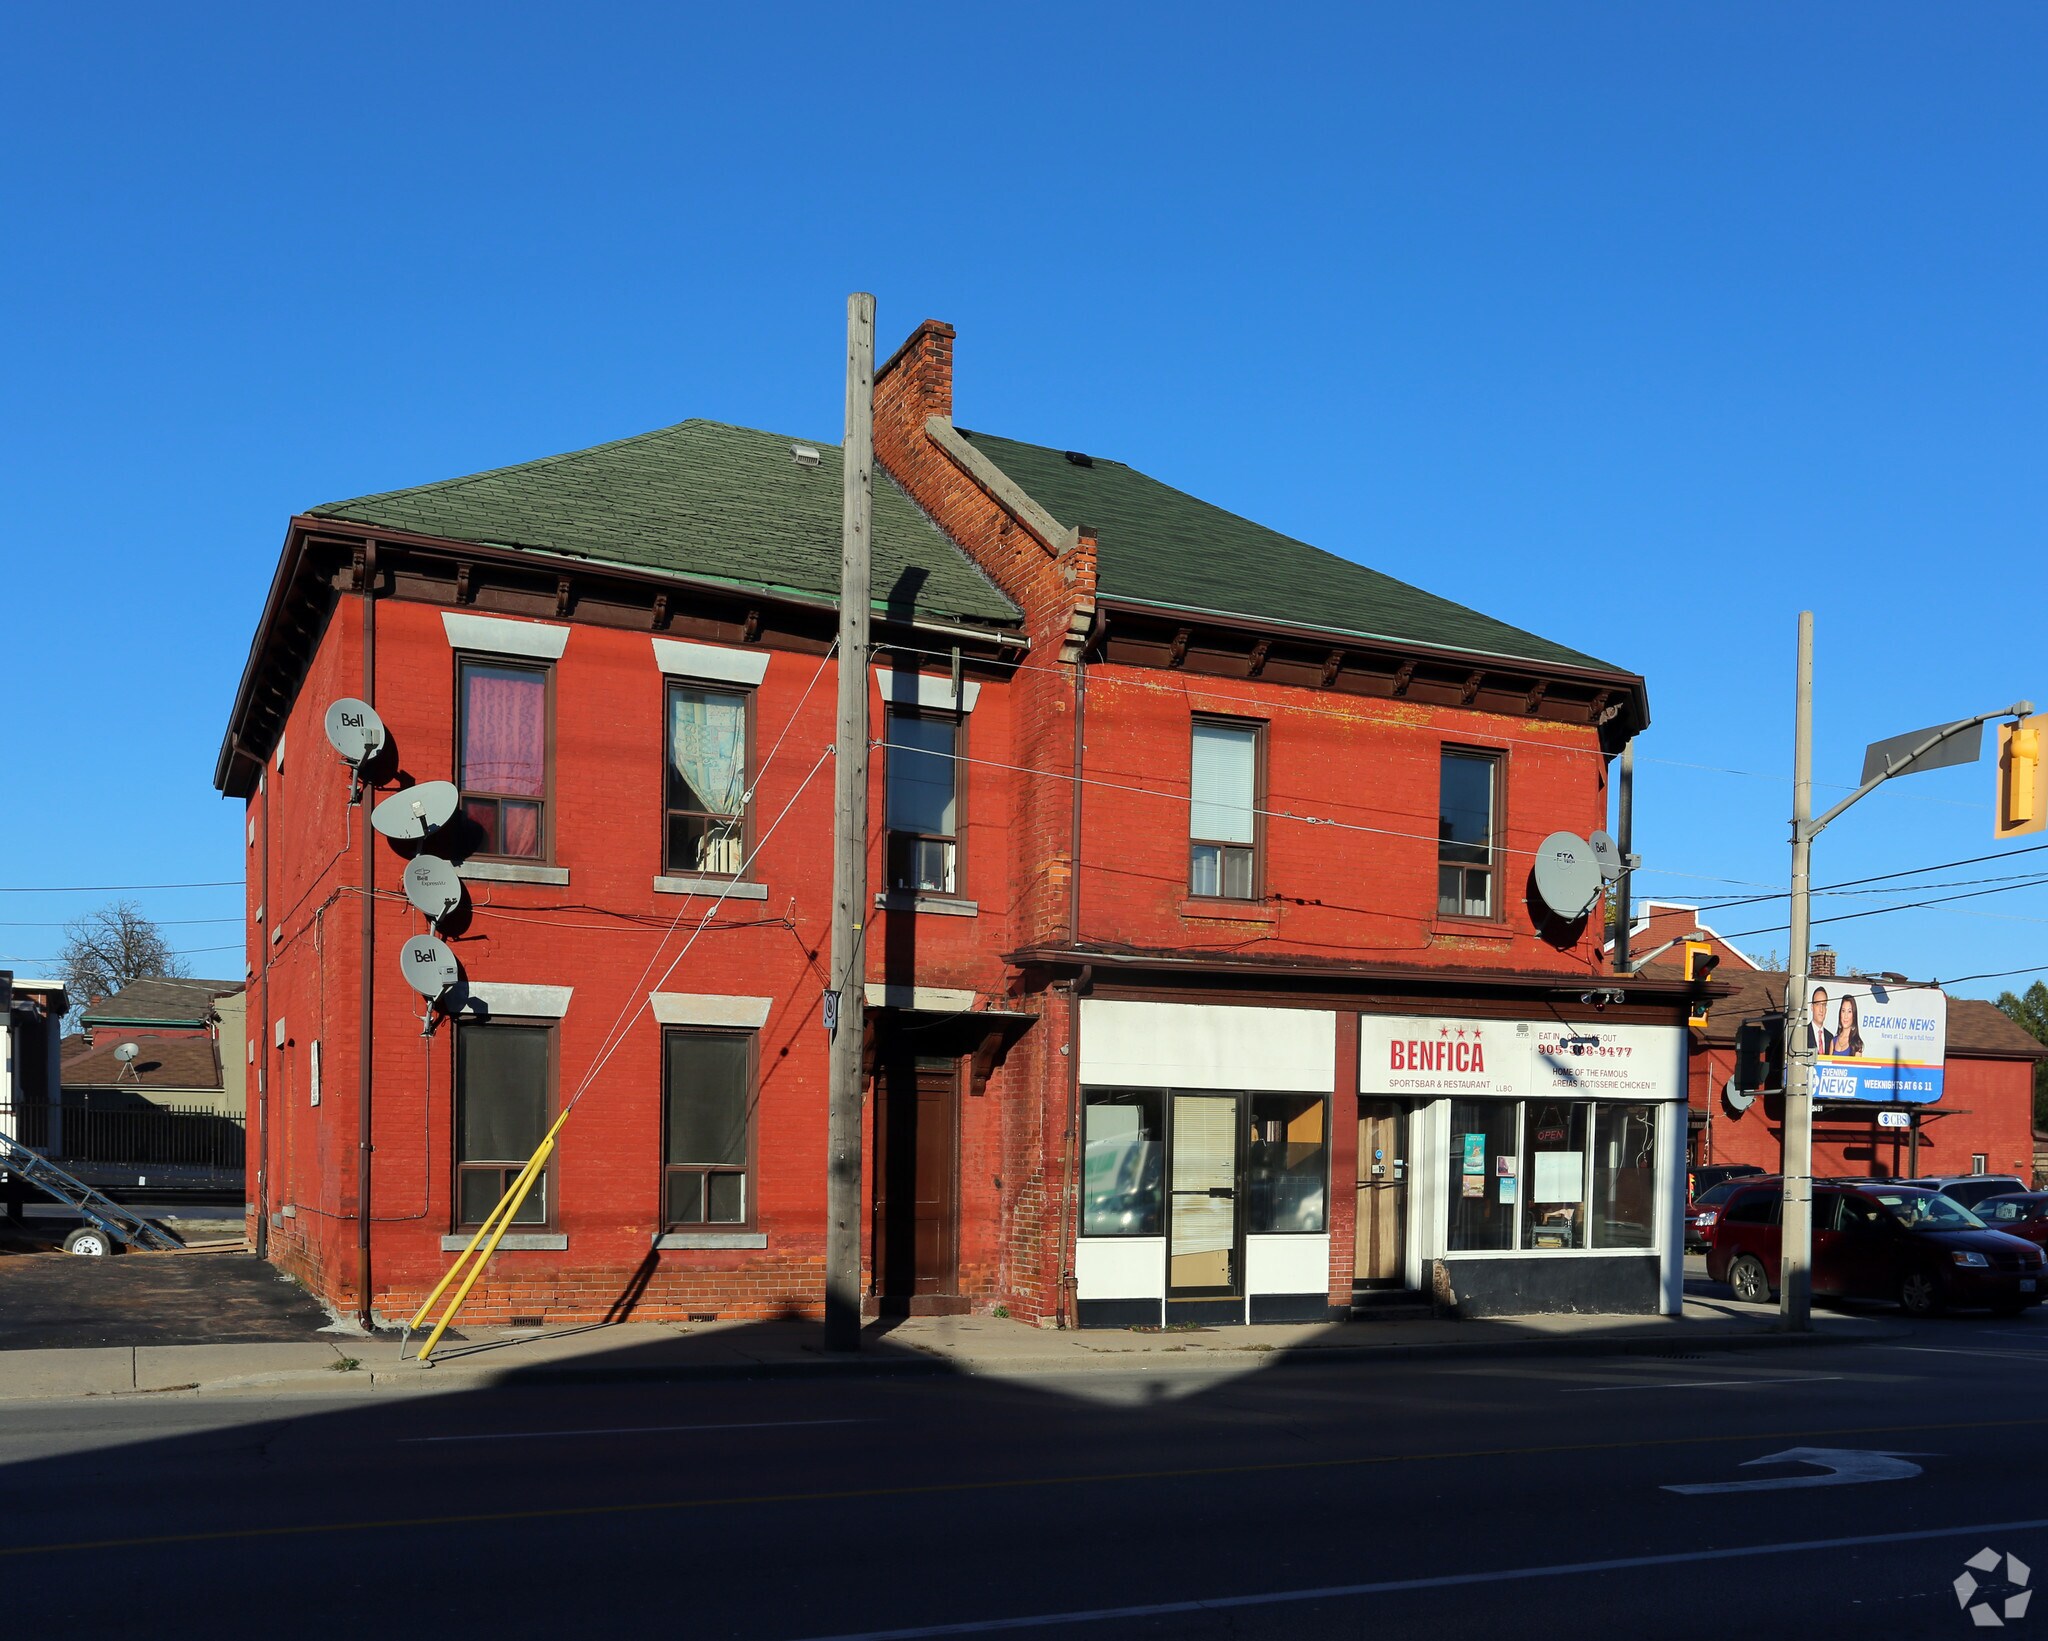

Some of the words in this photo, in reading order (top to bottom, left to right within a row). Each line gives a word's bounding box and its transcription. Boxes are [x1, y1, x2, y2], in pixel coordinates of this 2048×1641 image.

[341, 713, 364, 727] Bell
[1595, 842, 1607, 853] Bell
[414, 949, 437, 963] Bell
[1862, 1015, 1907, 1030] BREAKING
[1909, 1018, 1936, 1032] NEWS
[1539, 1032, 1551, 1040] EAT
[1553, 1032, 1560, 1040] IN
[1390, 1039, 1485, 1072] BENFICA
[1552, 1068, 1573, 1076] HOME
[1575, 1068, 1585, 1076] OF
[1586, 1069, 1599, 1077] THE
[1600, 1070, 1628, 1078] FAMOUS
[1822, 1068, 1848, 1077] EVENING
[1389, 1079, 1435, 1088] SPORTSBAR
[1437, 1080, 1442, 1088] &
[1444, 1080, 1491, 1088] RESTAURANT
[1580, 1080, 1619, 1088] ROTISSERIE
[1820, 1079, 1855, 1094] NEWS
[1864, 1079, 1903, 1090] WEEKNIGHTS
[1904, 1081, 1912, 1090] AT
[1913, 1081, 1917, 1090] 6
[1924, 1082, 1932, 1091] 11
[1890, 1114, 1908, 1125] CBS
[1537, 1130, 1564, 1140] OPEN
[1378, 1165, 1386, 1173] 19
